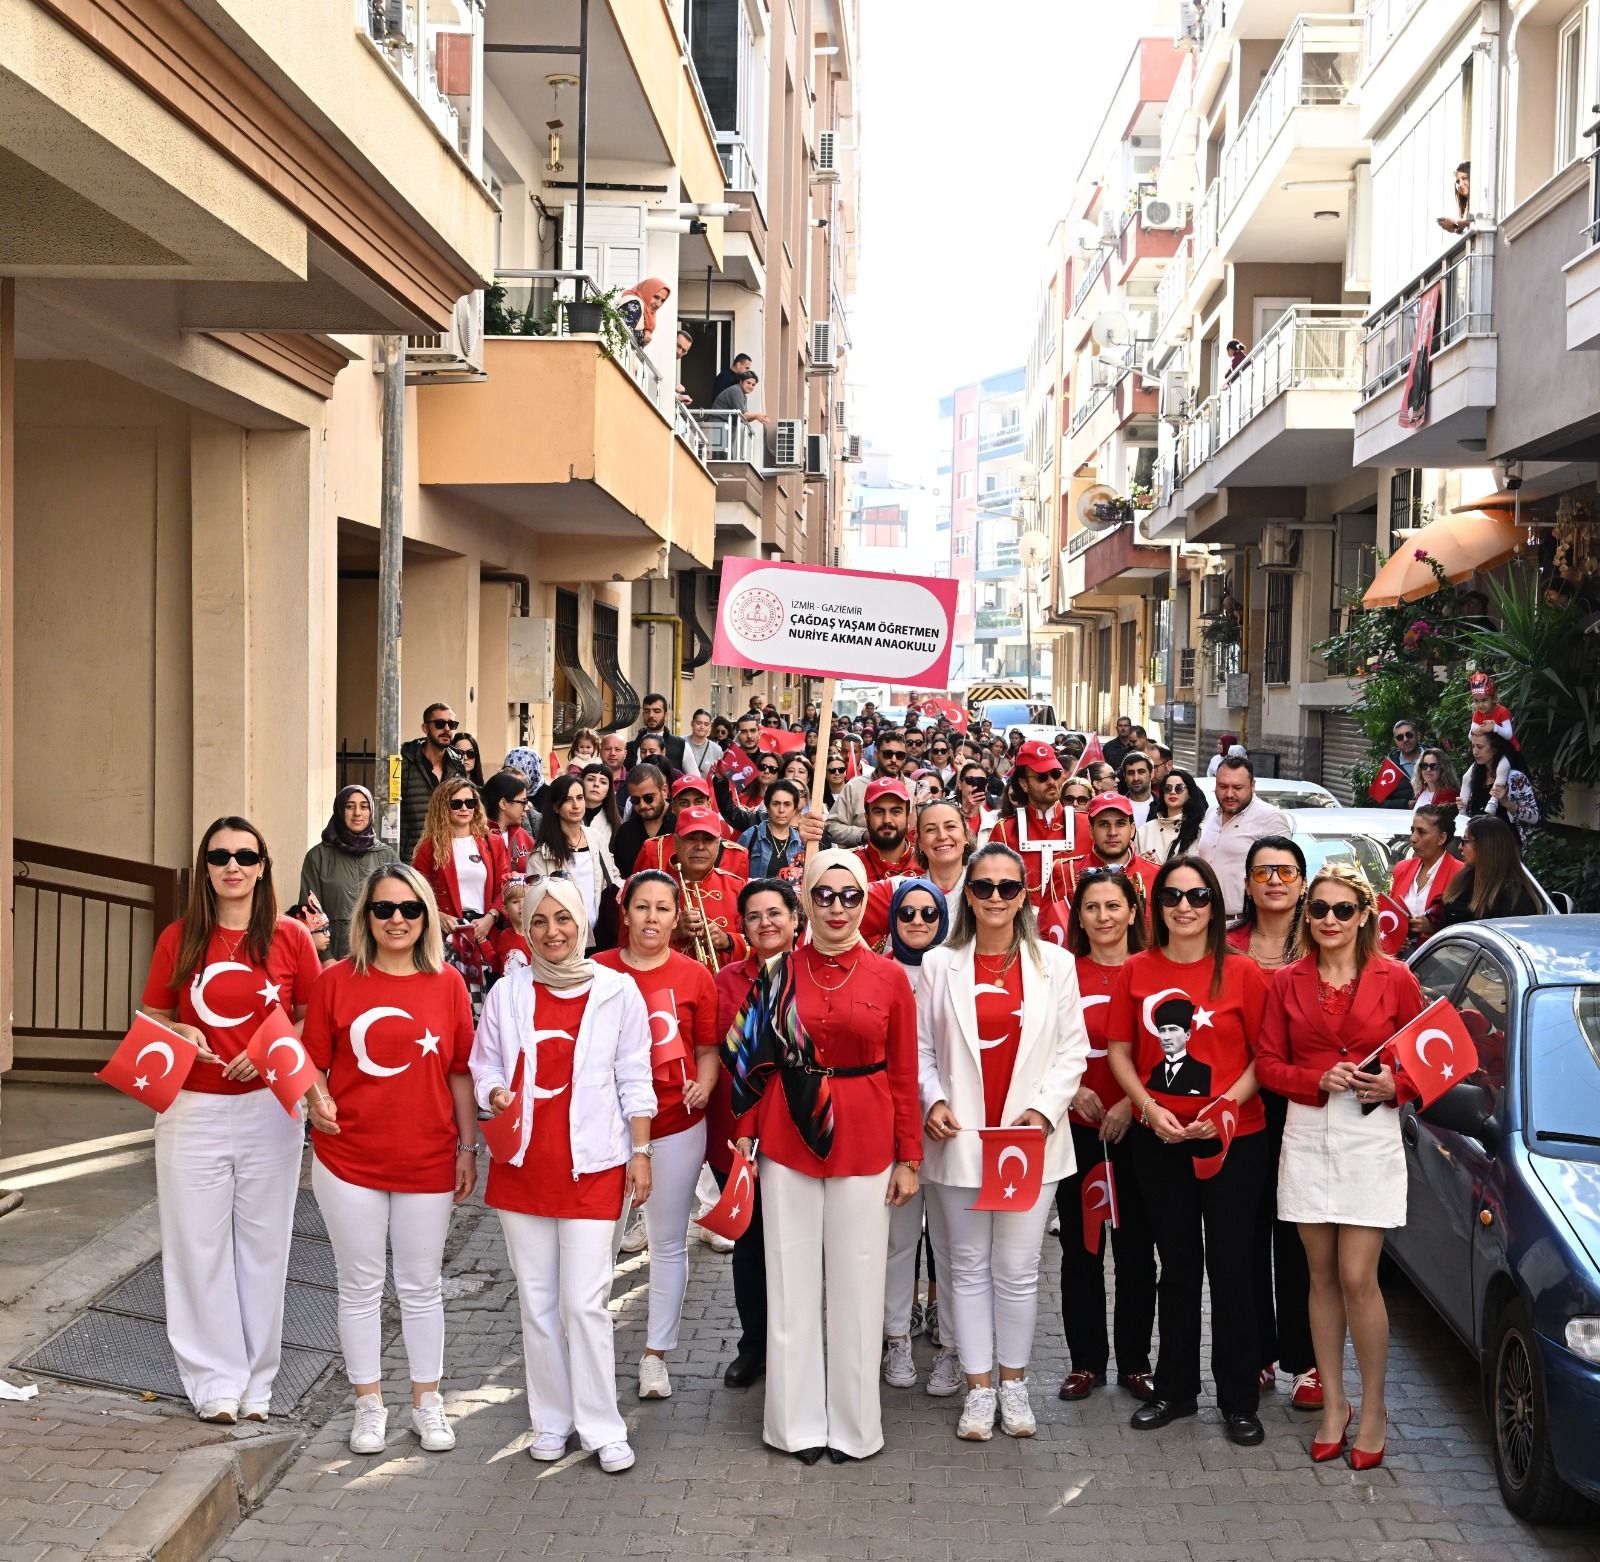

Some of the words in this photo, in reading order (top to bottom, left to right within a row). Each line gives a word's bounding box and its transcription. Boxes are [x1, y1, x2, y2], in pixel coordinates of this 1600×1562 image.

[790, 613, 836, 630] ÇAĞDAŞ
[838, 618, 876, 632] YAŞAM
[878, 621, 940, 639] ÖĞRETMEN
[788, 628, 829, 642] NURİYE
[830, 633, 872, 647] AKMAN
[874, 637, 936, 653] ANAOKULU
